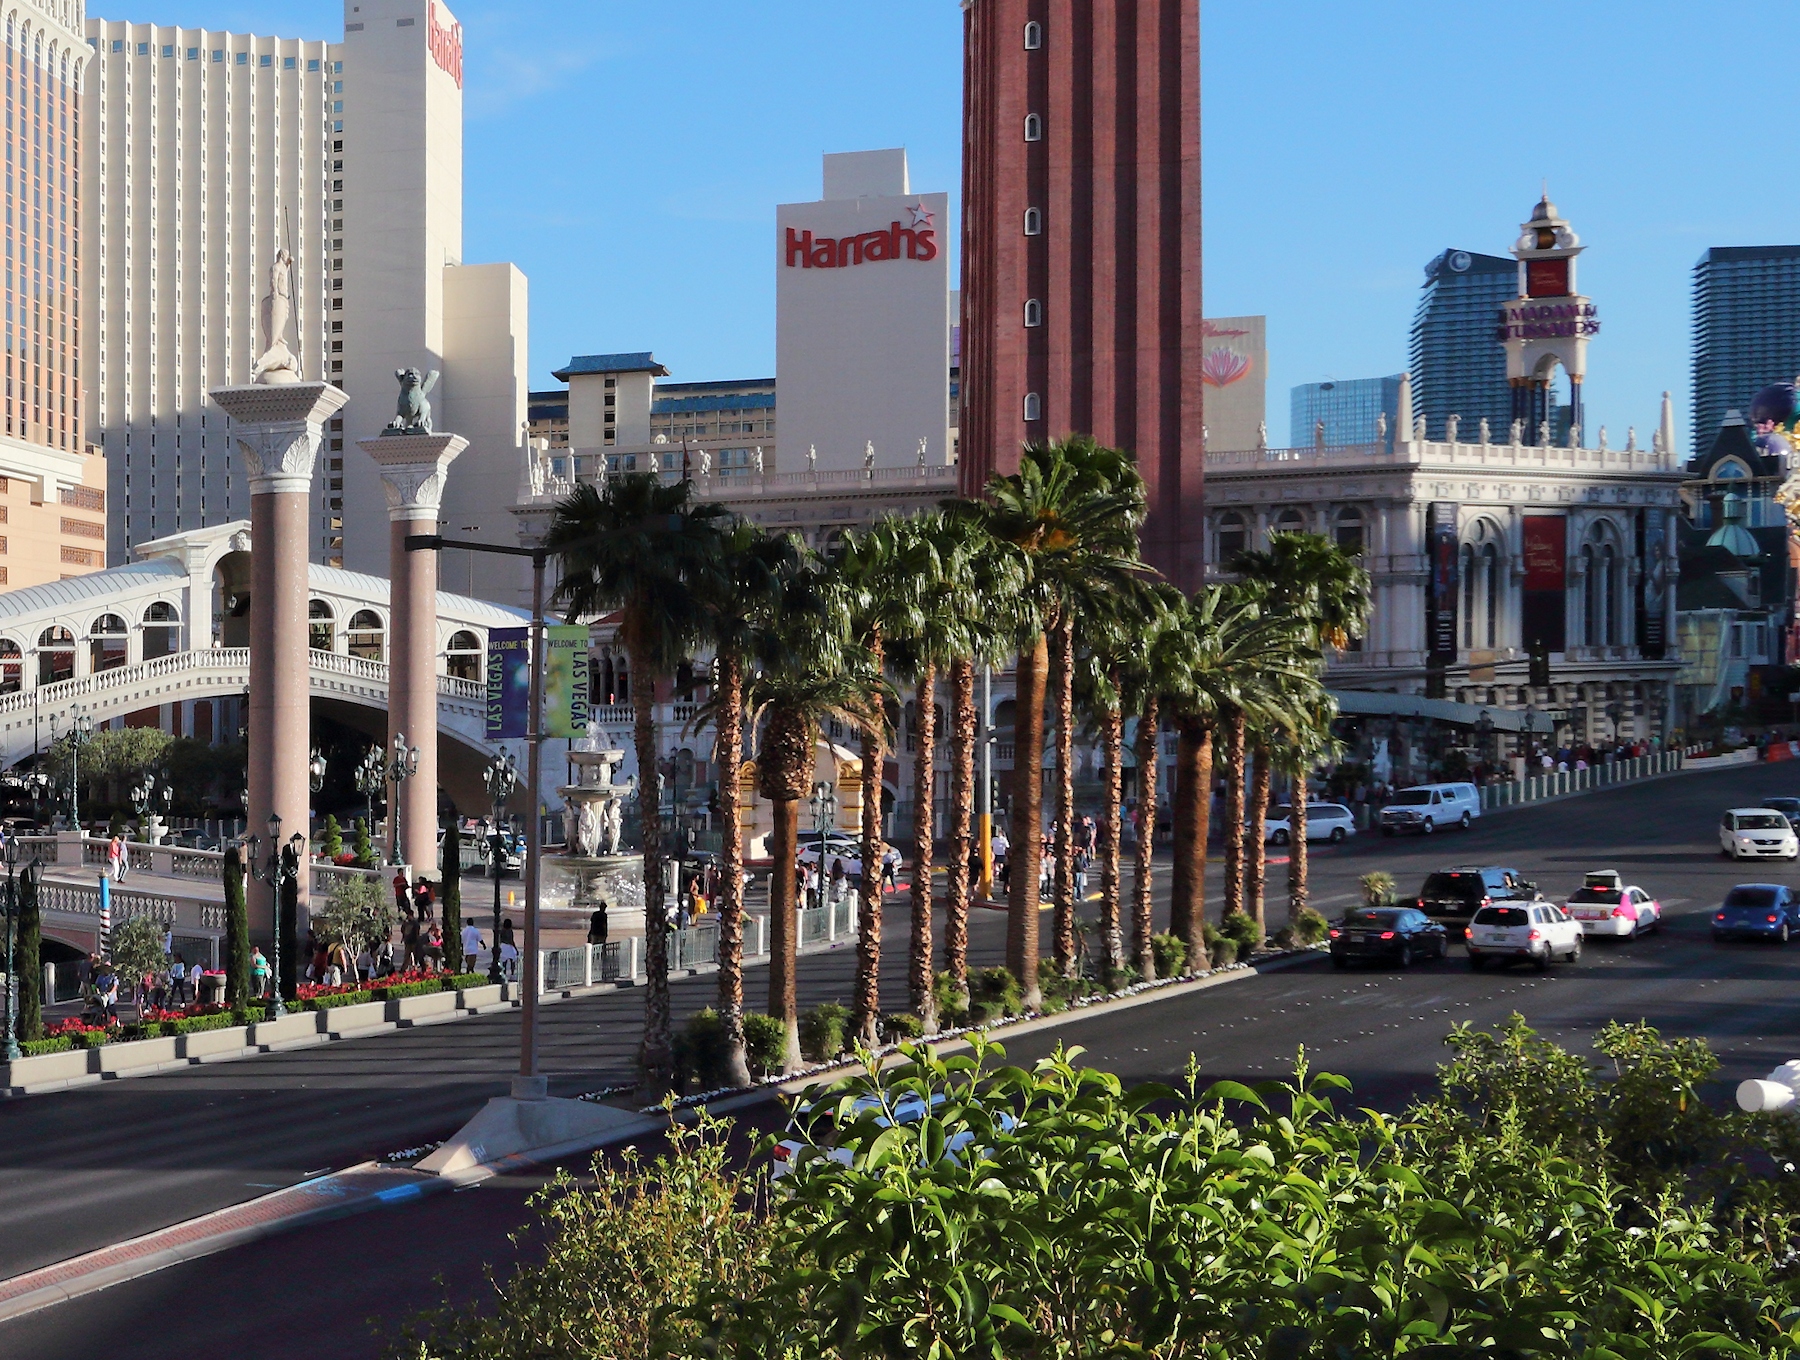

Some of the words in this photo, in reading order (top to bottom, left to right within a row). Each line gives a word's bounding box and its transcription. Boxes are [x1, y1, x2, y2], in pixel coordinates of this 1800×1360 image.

[488, 639, 518, 651] WELCOME
[520, 639, 528, 650] TO
[547, 639, 578, 648] WELCOME
[580, 639, 588, 648] TO
[488, 653, 503, 701] VEGAS
[572, 651, 588, 679] LAS
[488, 704, 502, 731] LAS
[571, 682, 588, 730] VEGAS
